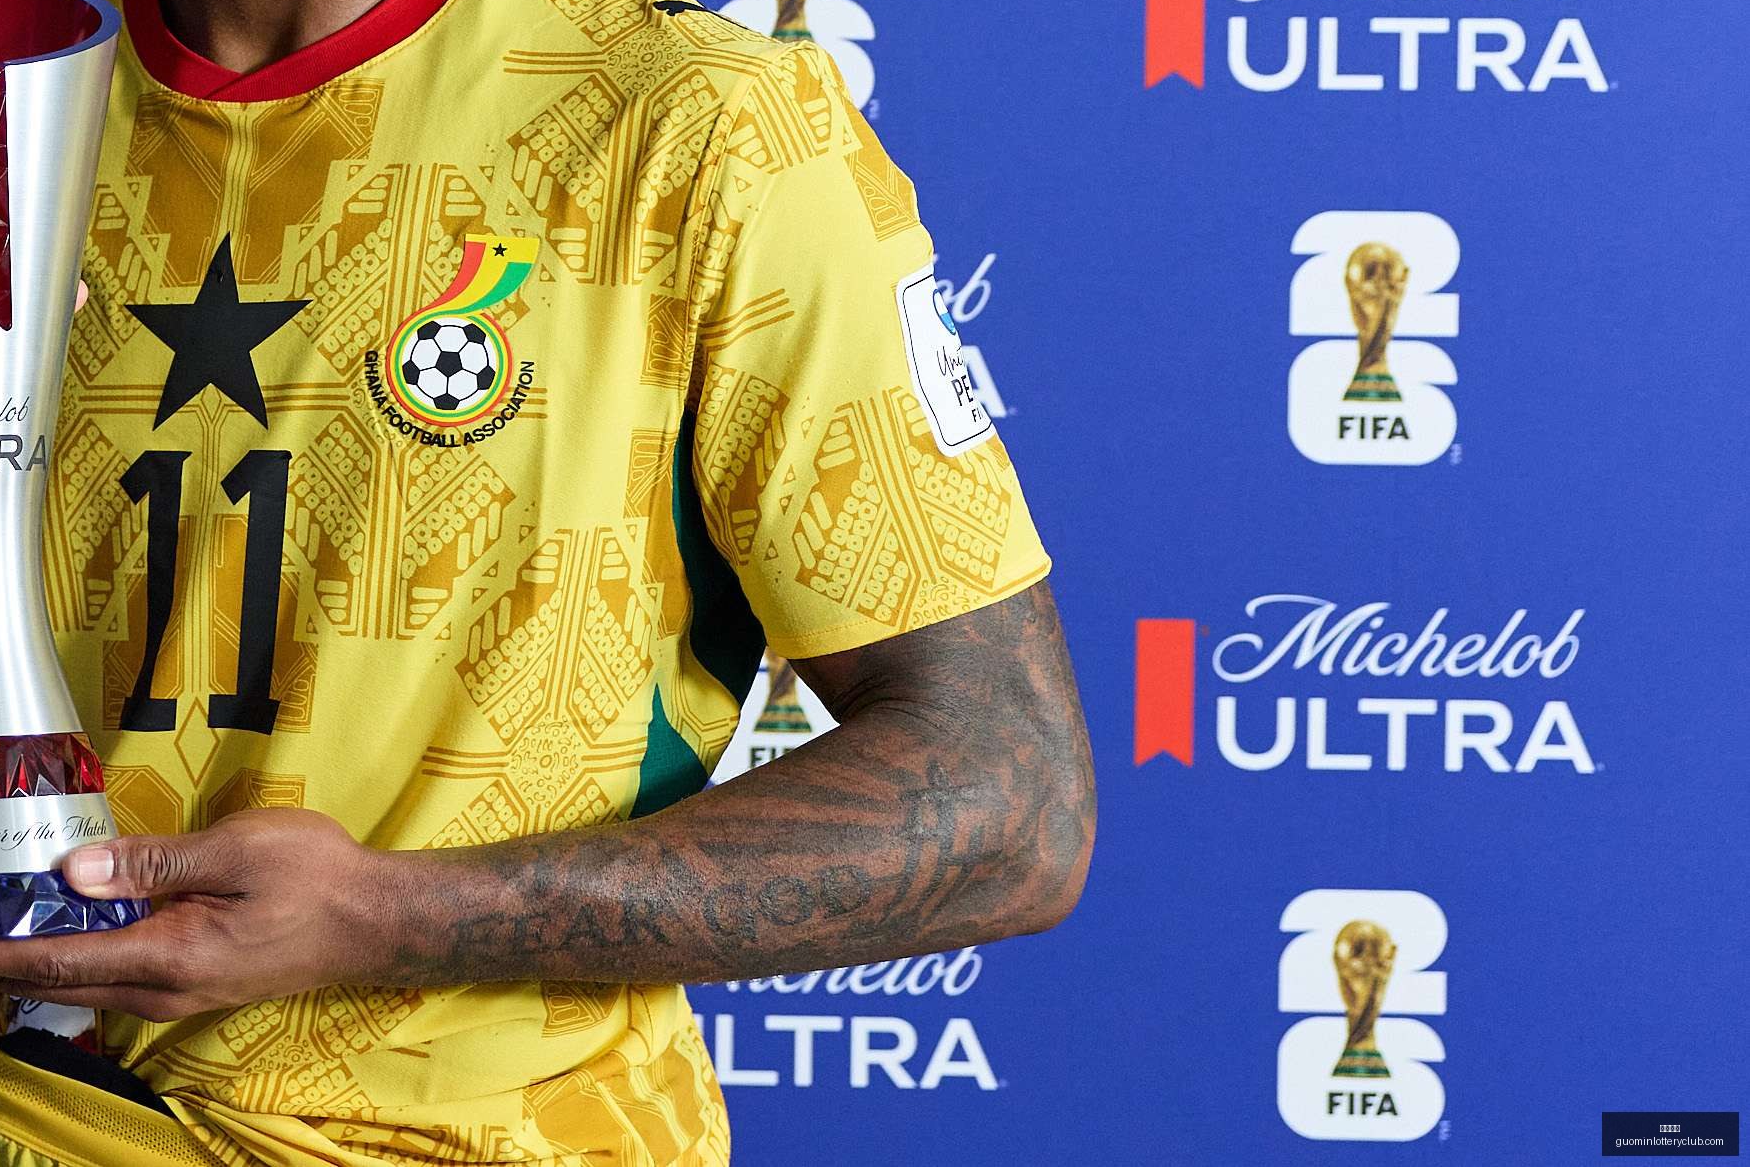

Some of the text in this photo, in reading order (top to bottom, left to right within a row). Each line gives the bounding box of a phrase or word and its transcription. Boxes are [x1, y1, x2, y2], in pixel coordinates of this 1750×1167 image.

[1228, 17, 1608, 92] ULTRA
[364, 350, 535, 448] GHANA FOOTBALL ASSOCIATION
[1338, 416, 1410, 440] FIFA
[117, 449, 292, 735] 11
[1213, 595, 1585, 682] Michelob
[749, 746, 797, 768] FI
[1217, 696, 1595, 773] ULTRA
[0, 821, 39, 851] of
[33, 821, 55, 840] the
[63, 815, 107, 841] Match
[693, 1013, 998, 1091] LTRA
[1327, 1091, 1398, 1117] FIFA
